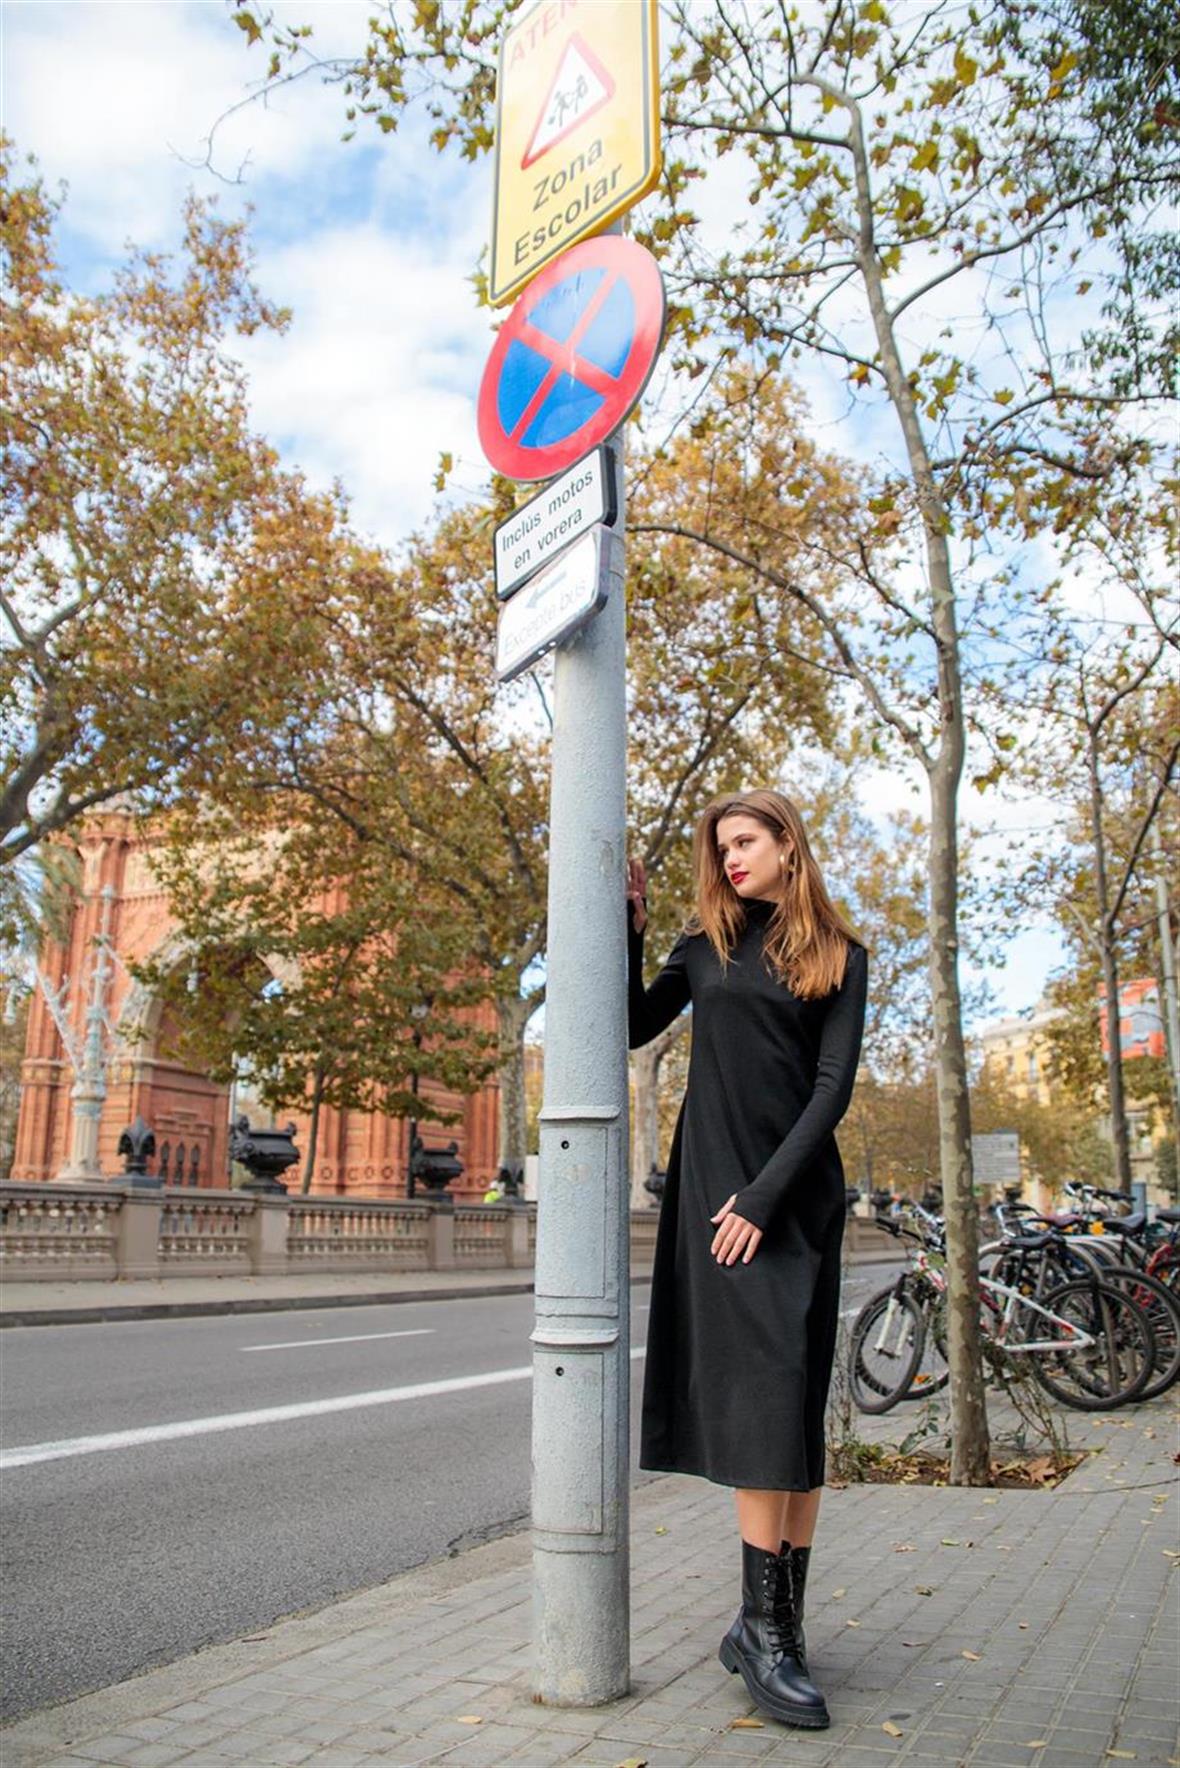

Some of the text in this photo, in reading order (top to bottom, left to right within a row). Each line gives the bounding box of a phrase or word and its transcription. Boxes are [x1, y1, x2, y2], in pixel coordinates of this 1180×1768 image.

[533, 139, 603, 212] Zona
[514, 163, 622, 266] Escolar
[502, 471, 593, 552] Inclús motos
[514, 508, 583, 569] en vorera
